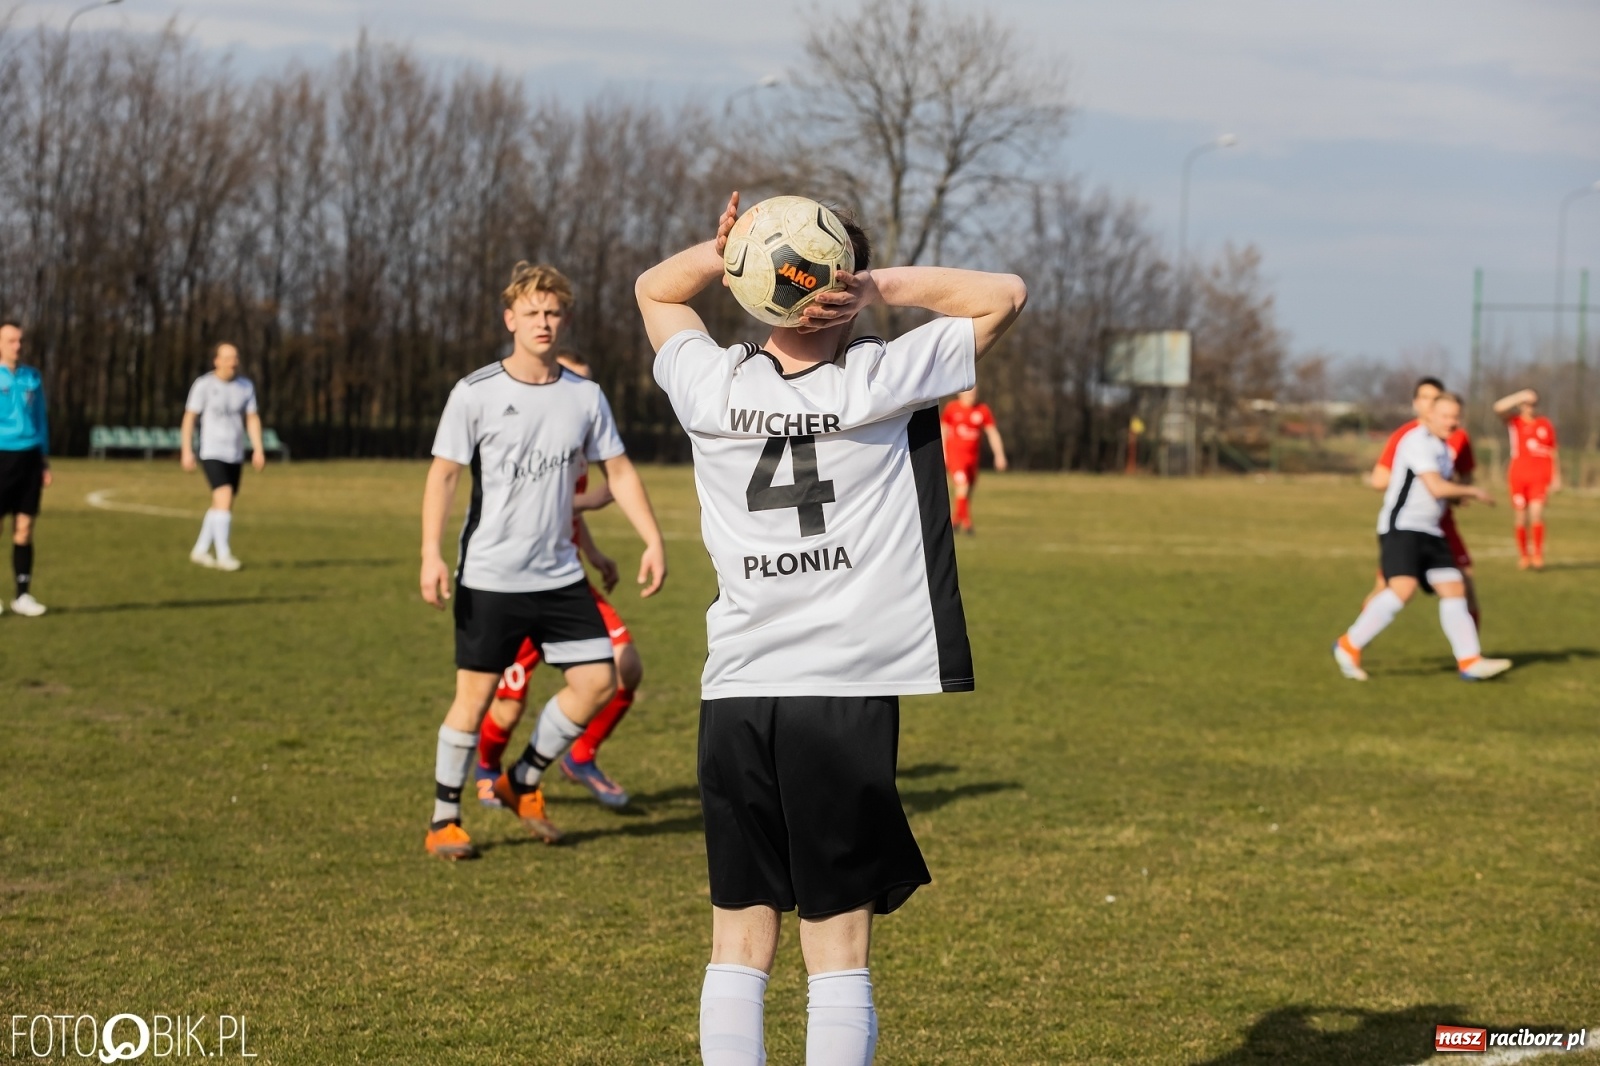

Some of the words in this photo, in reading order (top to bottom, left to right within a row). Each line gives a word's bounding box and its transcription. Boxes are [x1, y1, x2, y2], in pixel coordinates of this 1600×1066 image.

[778, 262, 817, 289] JAKO
[730, 408, 842, 436] WICHER
[746, 435, 836, 538] 4
[743, 546, 853, 579] PŁONIA
